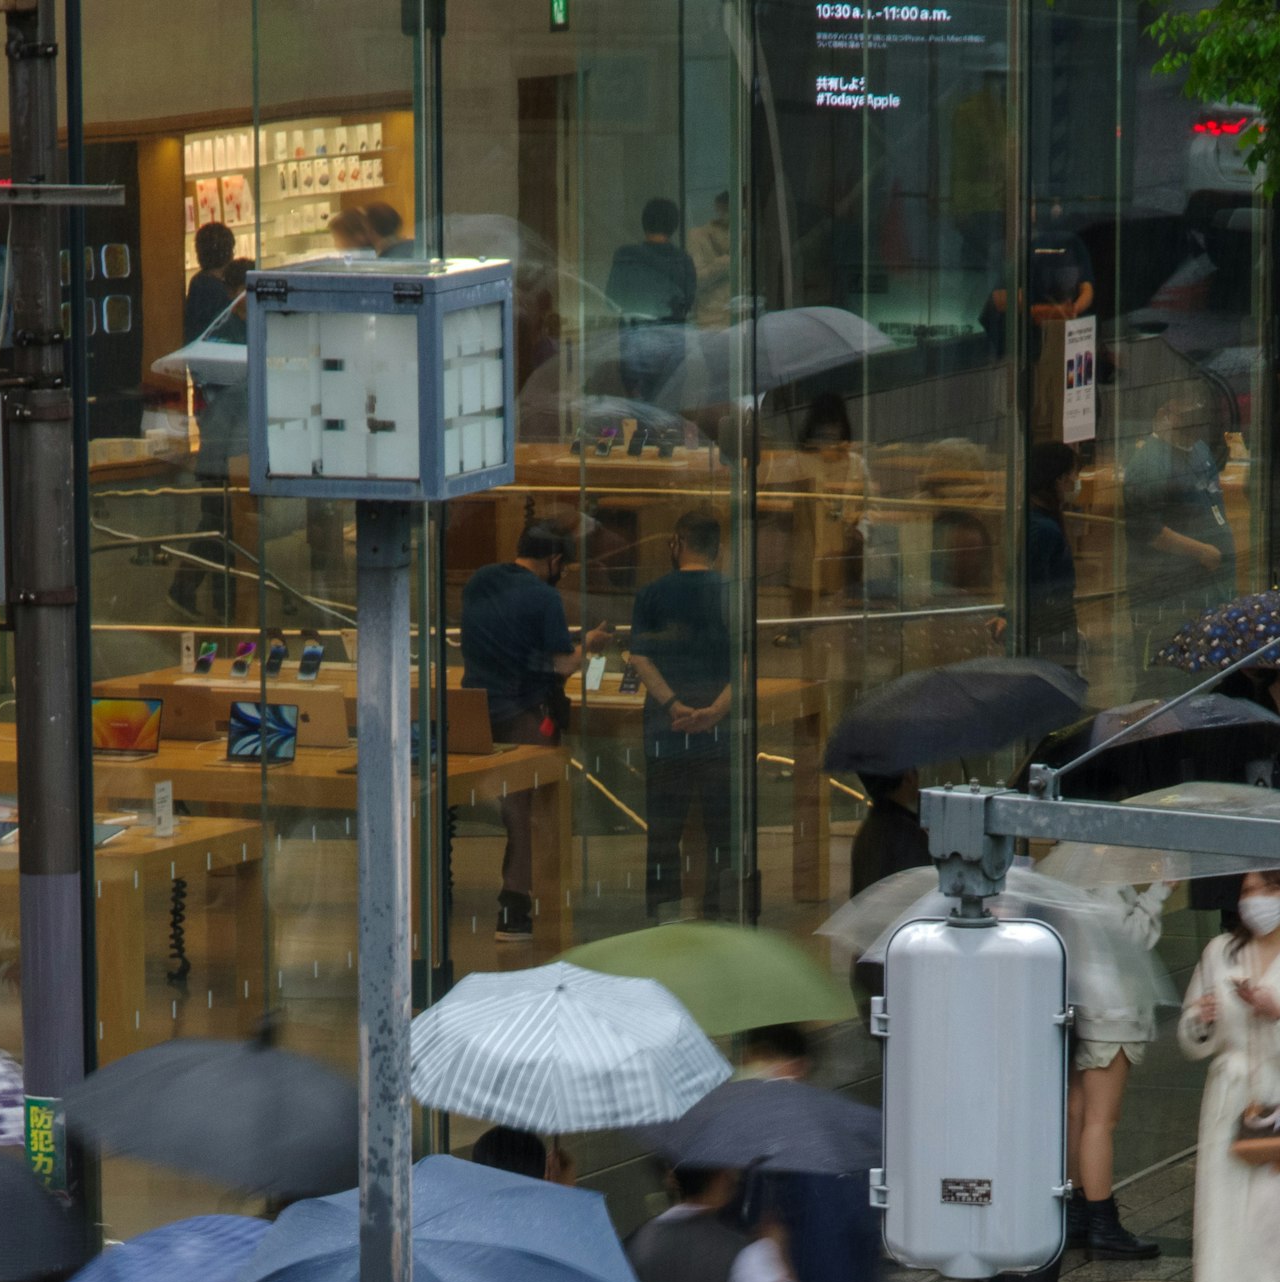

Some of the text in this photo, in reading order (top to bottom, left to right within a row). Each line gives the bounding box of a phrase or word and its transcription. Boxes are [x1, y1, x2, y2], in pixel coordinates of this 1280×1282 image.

[816, 4, 850, 19] 10:30
[29, 1106, 55, 1186] 防犯カ
